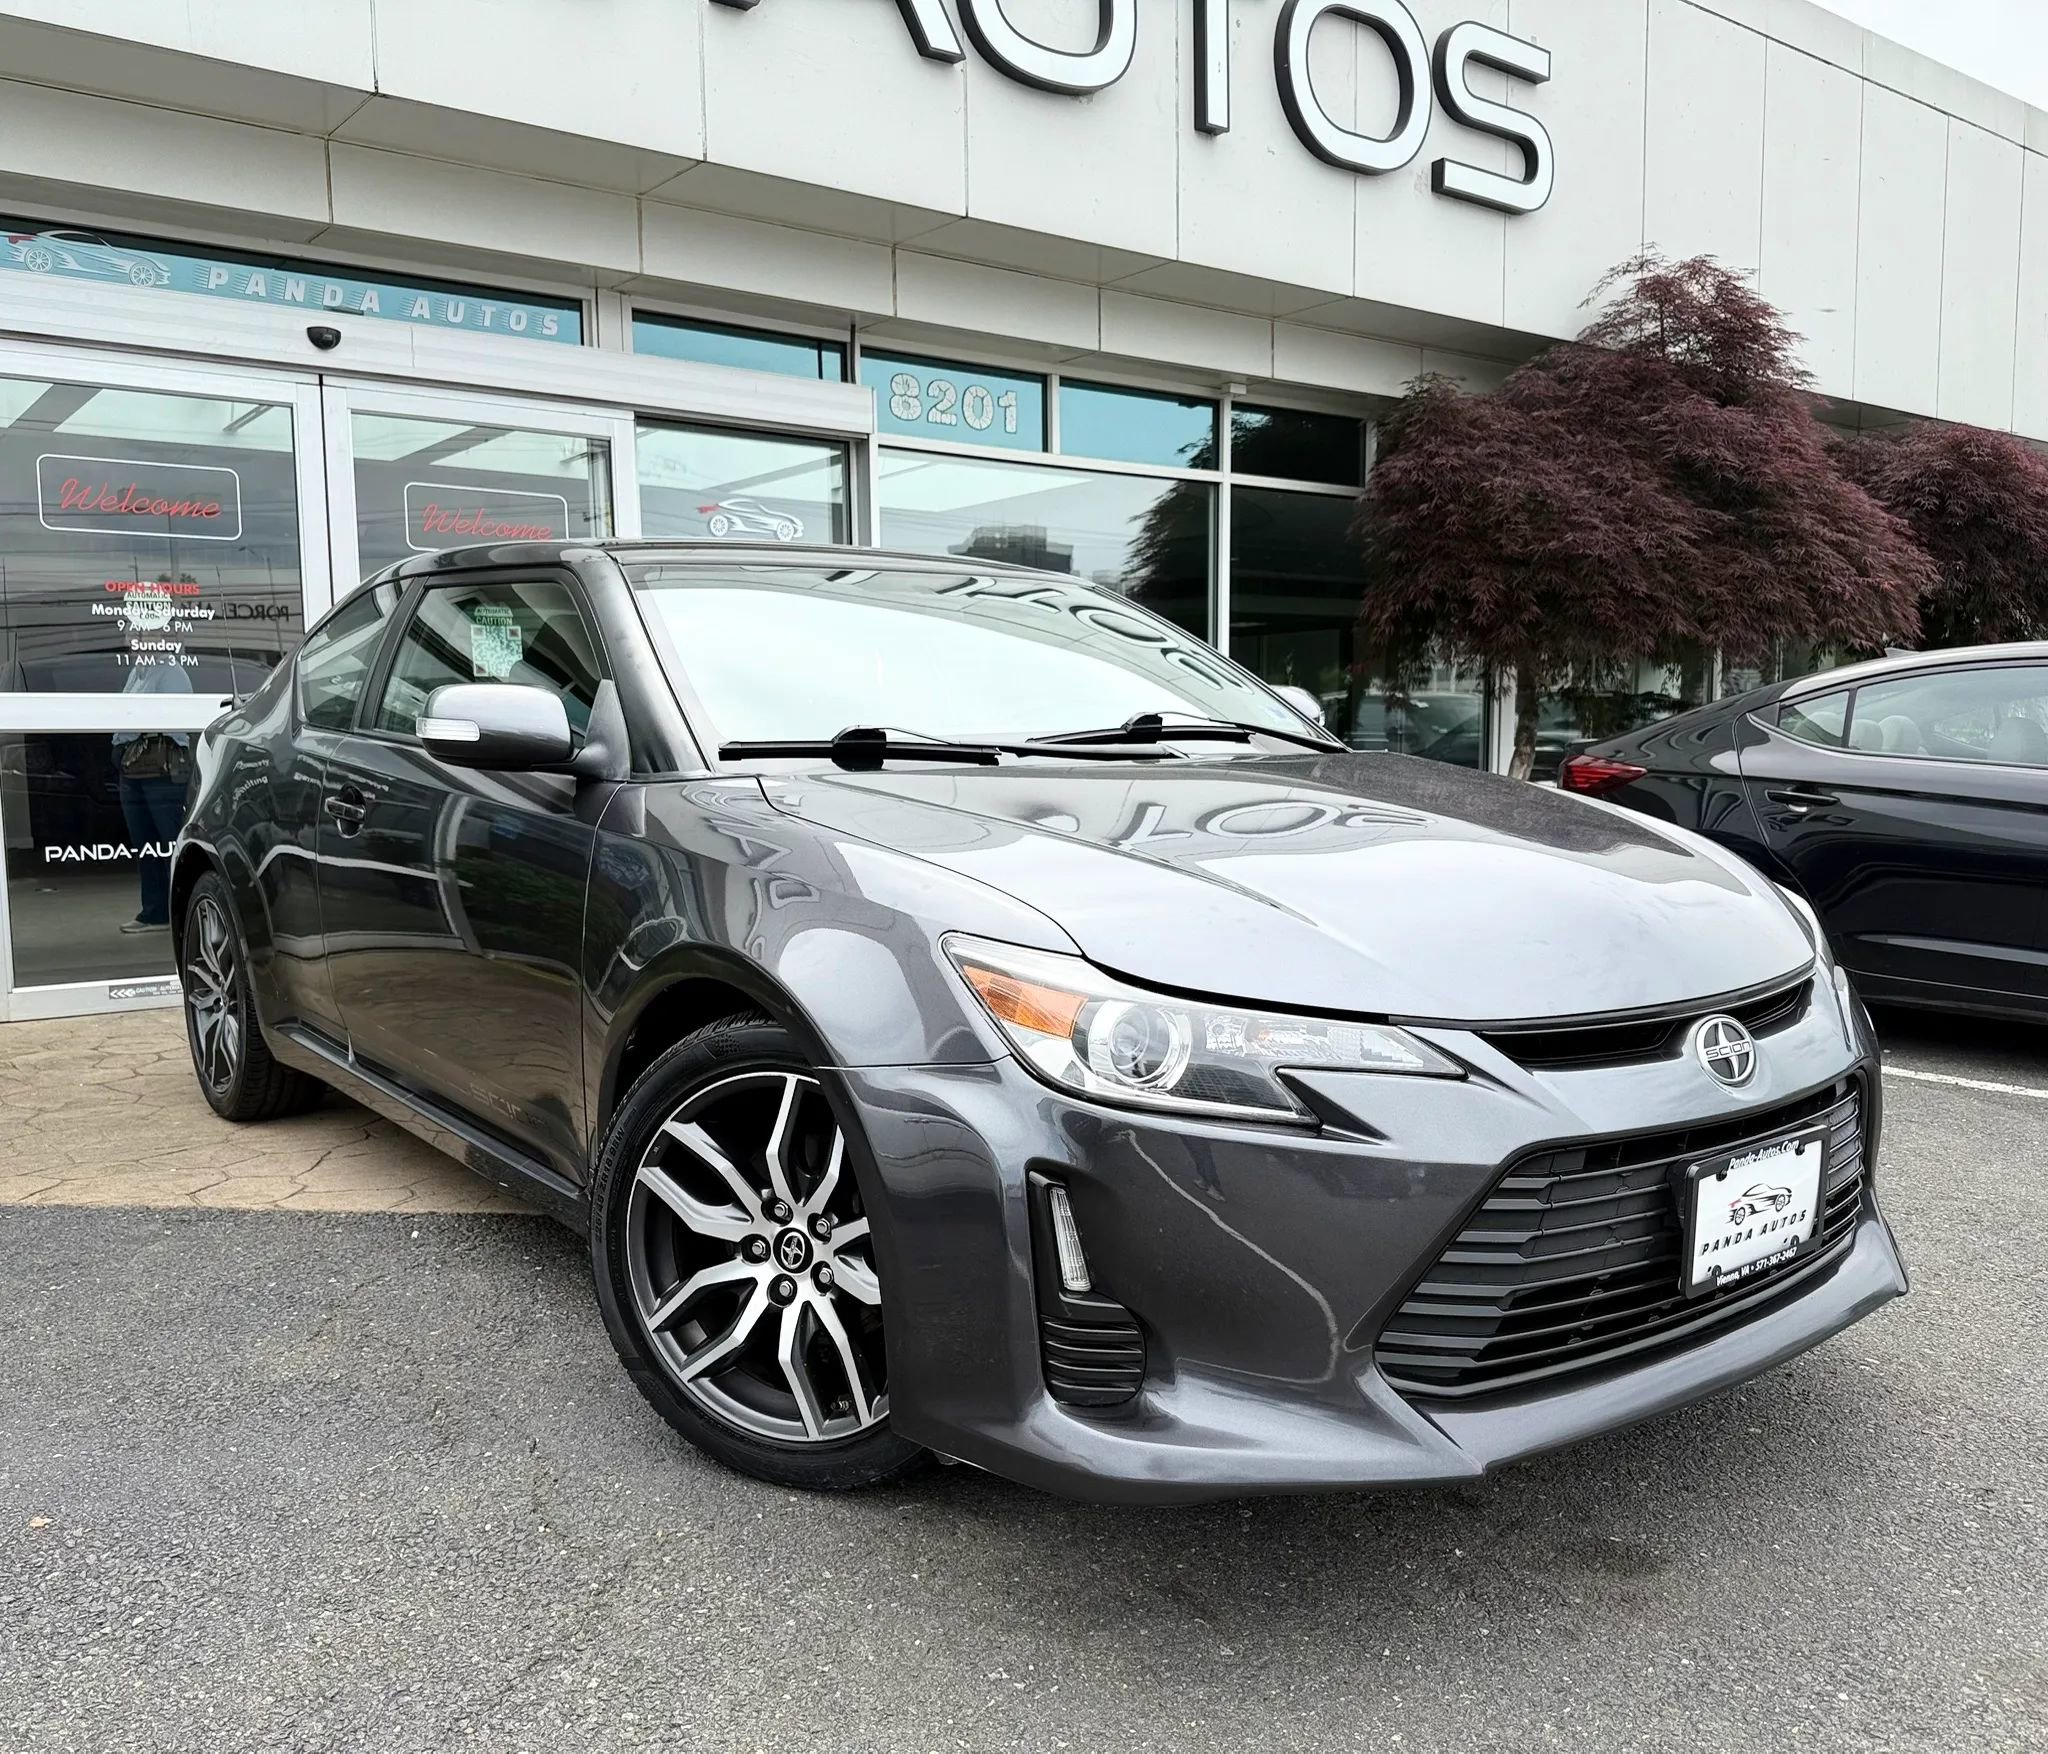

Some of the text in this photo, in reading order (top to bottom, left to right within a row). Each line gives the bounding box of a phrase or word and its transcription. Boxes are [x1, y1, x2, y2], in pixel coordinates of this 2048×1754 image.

[206, 266, 560, 335] PANDA AUTOS
[889, 373, 1018, 435] 8201
[59, 477, 222, 519] Welcome
[422, 503, 554, 540] Welcome
[105, 581, 200, 595] OPEN HOURS
[117, 619, 194, 633] 9 AM 6 PM
[475, 616, 513, 627] CAUTION
[130, 638, 183, 652] Sunday
[115, 654, 130, 666] 11
[134, 655, 156, 666] AM
[168, 656, 176, 666] 3
[179, 656, 199, 666] PM
[45, 841, 176, 863] PANDA-AU
[1701, 1209, 1807, 1257] PANDA AUTOS
